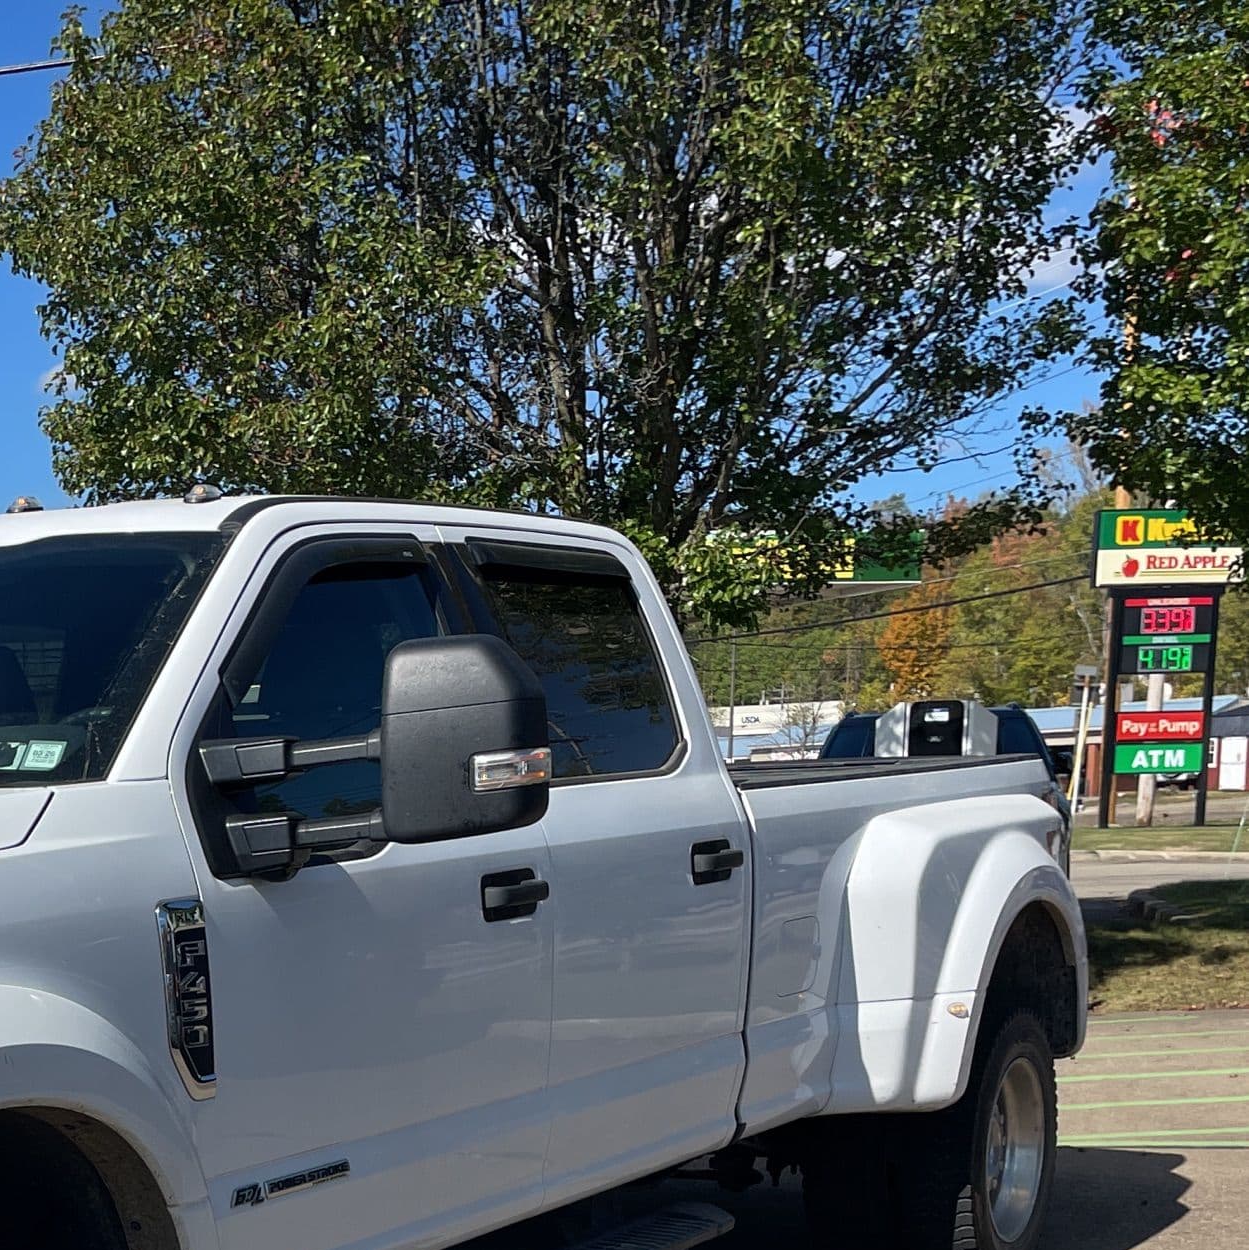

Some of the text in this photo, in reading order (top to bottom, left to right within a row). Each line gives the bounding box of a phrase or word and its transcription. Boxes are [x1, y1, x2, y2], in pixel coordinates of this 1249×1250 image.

[1121, 519, 1141, 542] K
[1146, 554, 1230, 570] RED APPLE
[1121, 720, 1148, 736] Pay
[1158, 719, 1200, 735] Pump
[1131, 749, 1186, 768] ATM
[268, 1174, 307, 1194] POWER
[307, 1161, 350, 1183] STROKE
